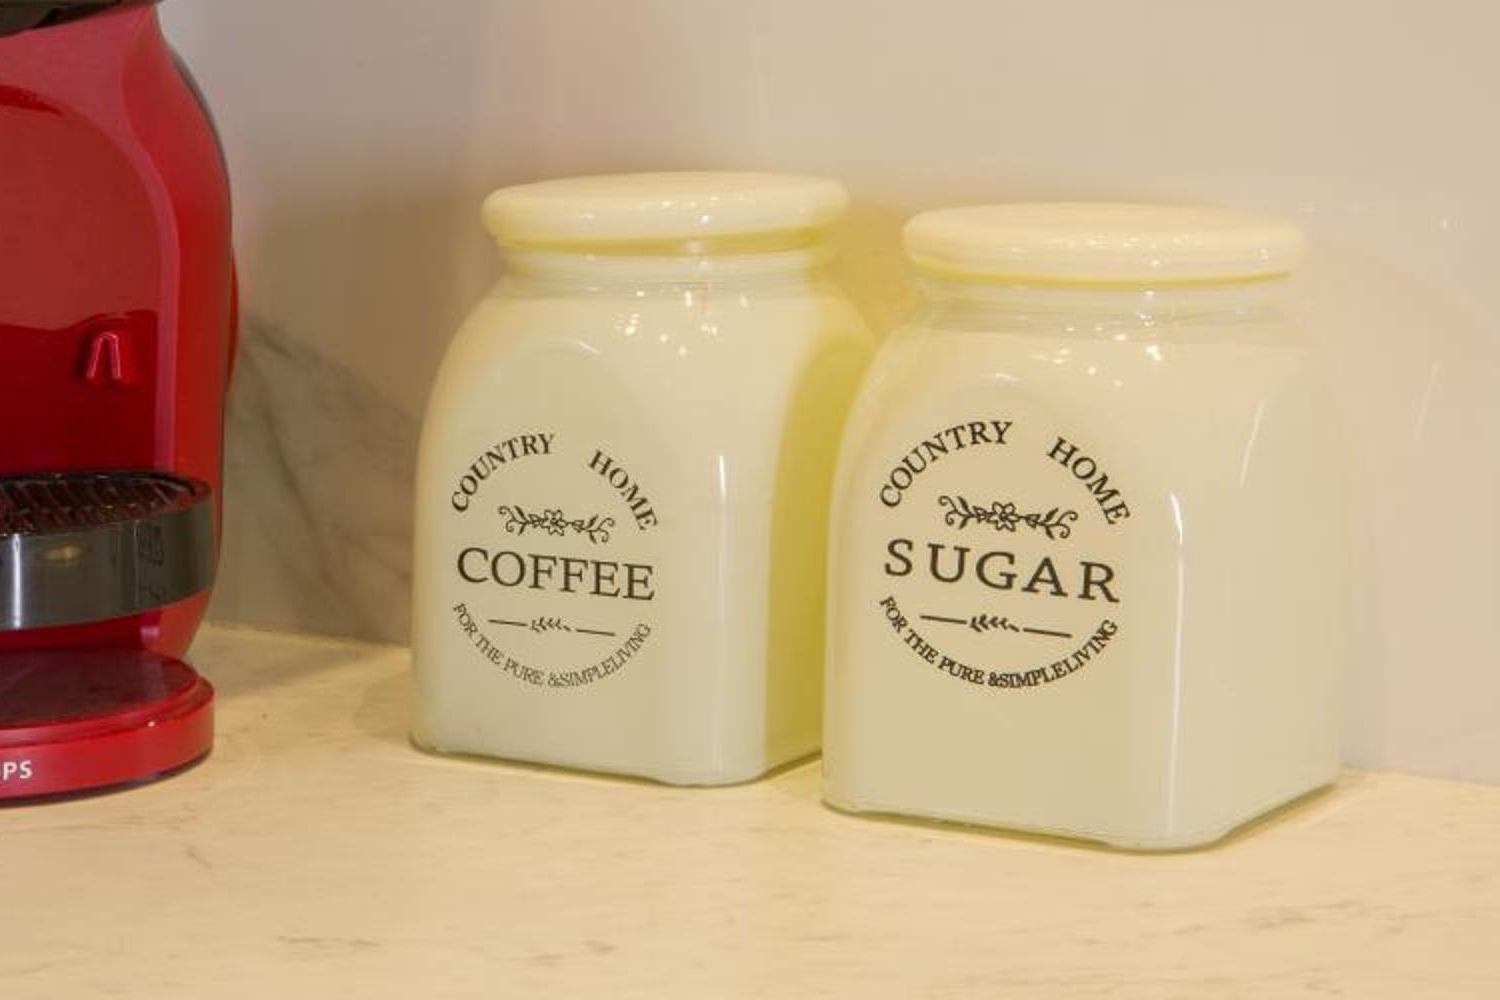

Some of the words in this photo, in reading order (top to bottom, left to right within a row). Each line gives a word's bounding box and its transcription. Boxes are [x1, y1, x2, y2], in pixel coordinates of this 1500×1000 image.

[451, 433, 555, 512] COUNTRY
[588, 450, 659, 531] HOME
[880, 421, 1012, 508] COUNTRY
[1046, 437, 1131, 524] HOME
[457, 547, 655, 600] COFFEE
[884, 539, 1120, 603] SUGAR
[453, 603, 478, 638] FOR
[475, 634, 505, 665] THE
[503, 657, 544, 686] PURE
[879, 596, 908, 633] FOR
[904, 629, 942, 664] THE
[938, 657, 984, 685] PURE
